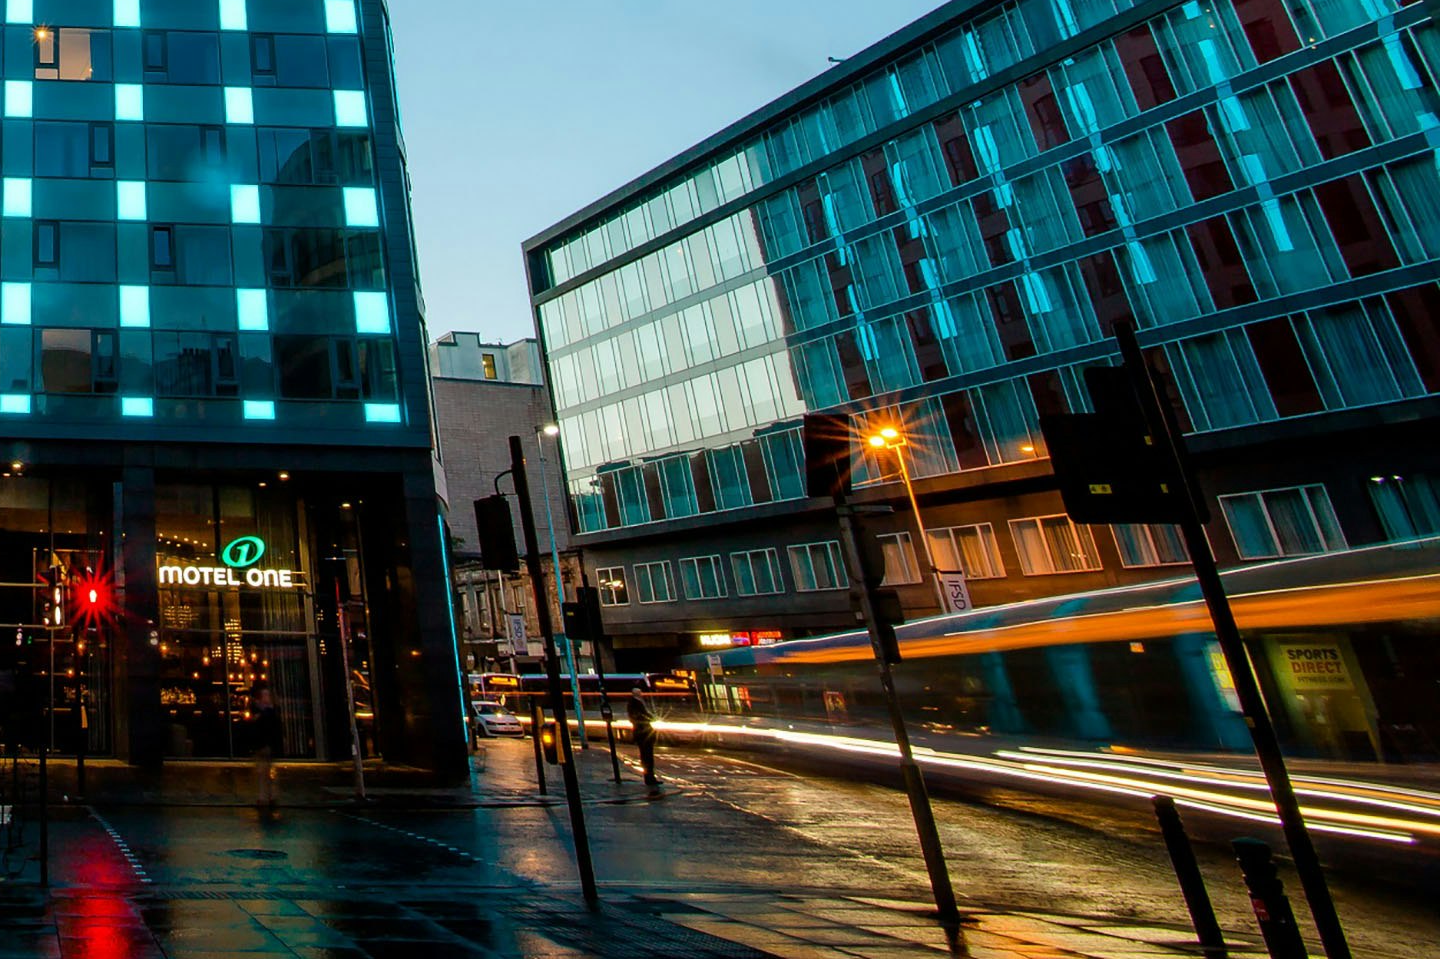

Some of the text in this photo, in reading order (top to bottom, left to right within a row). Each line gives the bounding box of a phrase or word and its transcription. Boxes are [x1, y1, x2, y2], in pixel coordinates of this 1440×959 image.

[158, 564, 292, 589] MOTEL ONE
[948, 580, 967, 610] IFSD
[512, 618, 523, 639] IFSD
[1287, 648, 1339, 661] SPORTS
[1290, 660, 1343, 674] DIRECT
